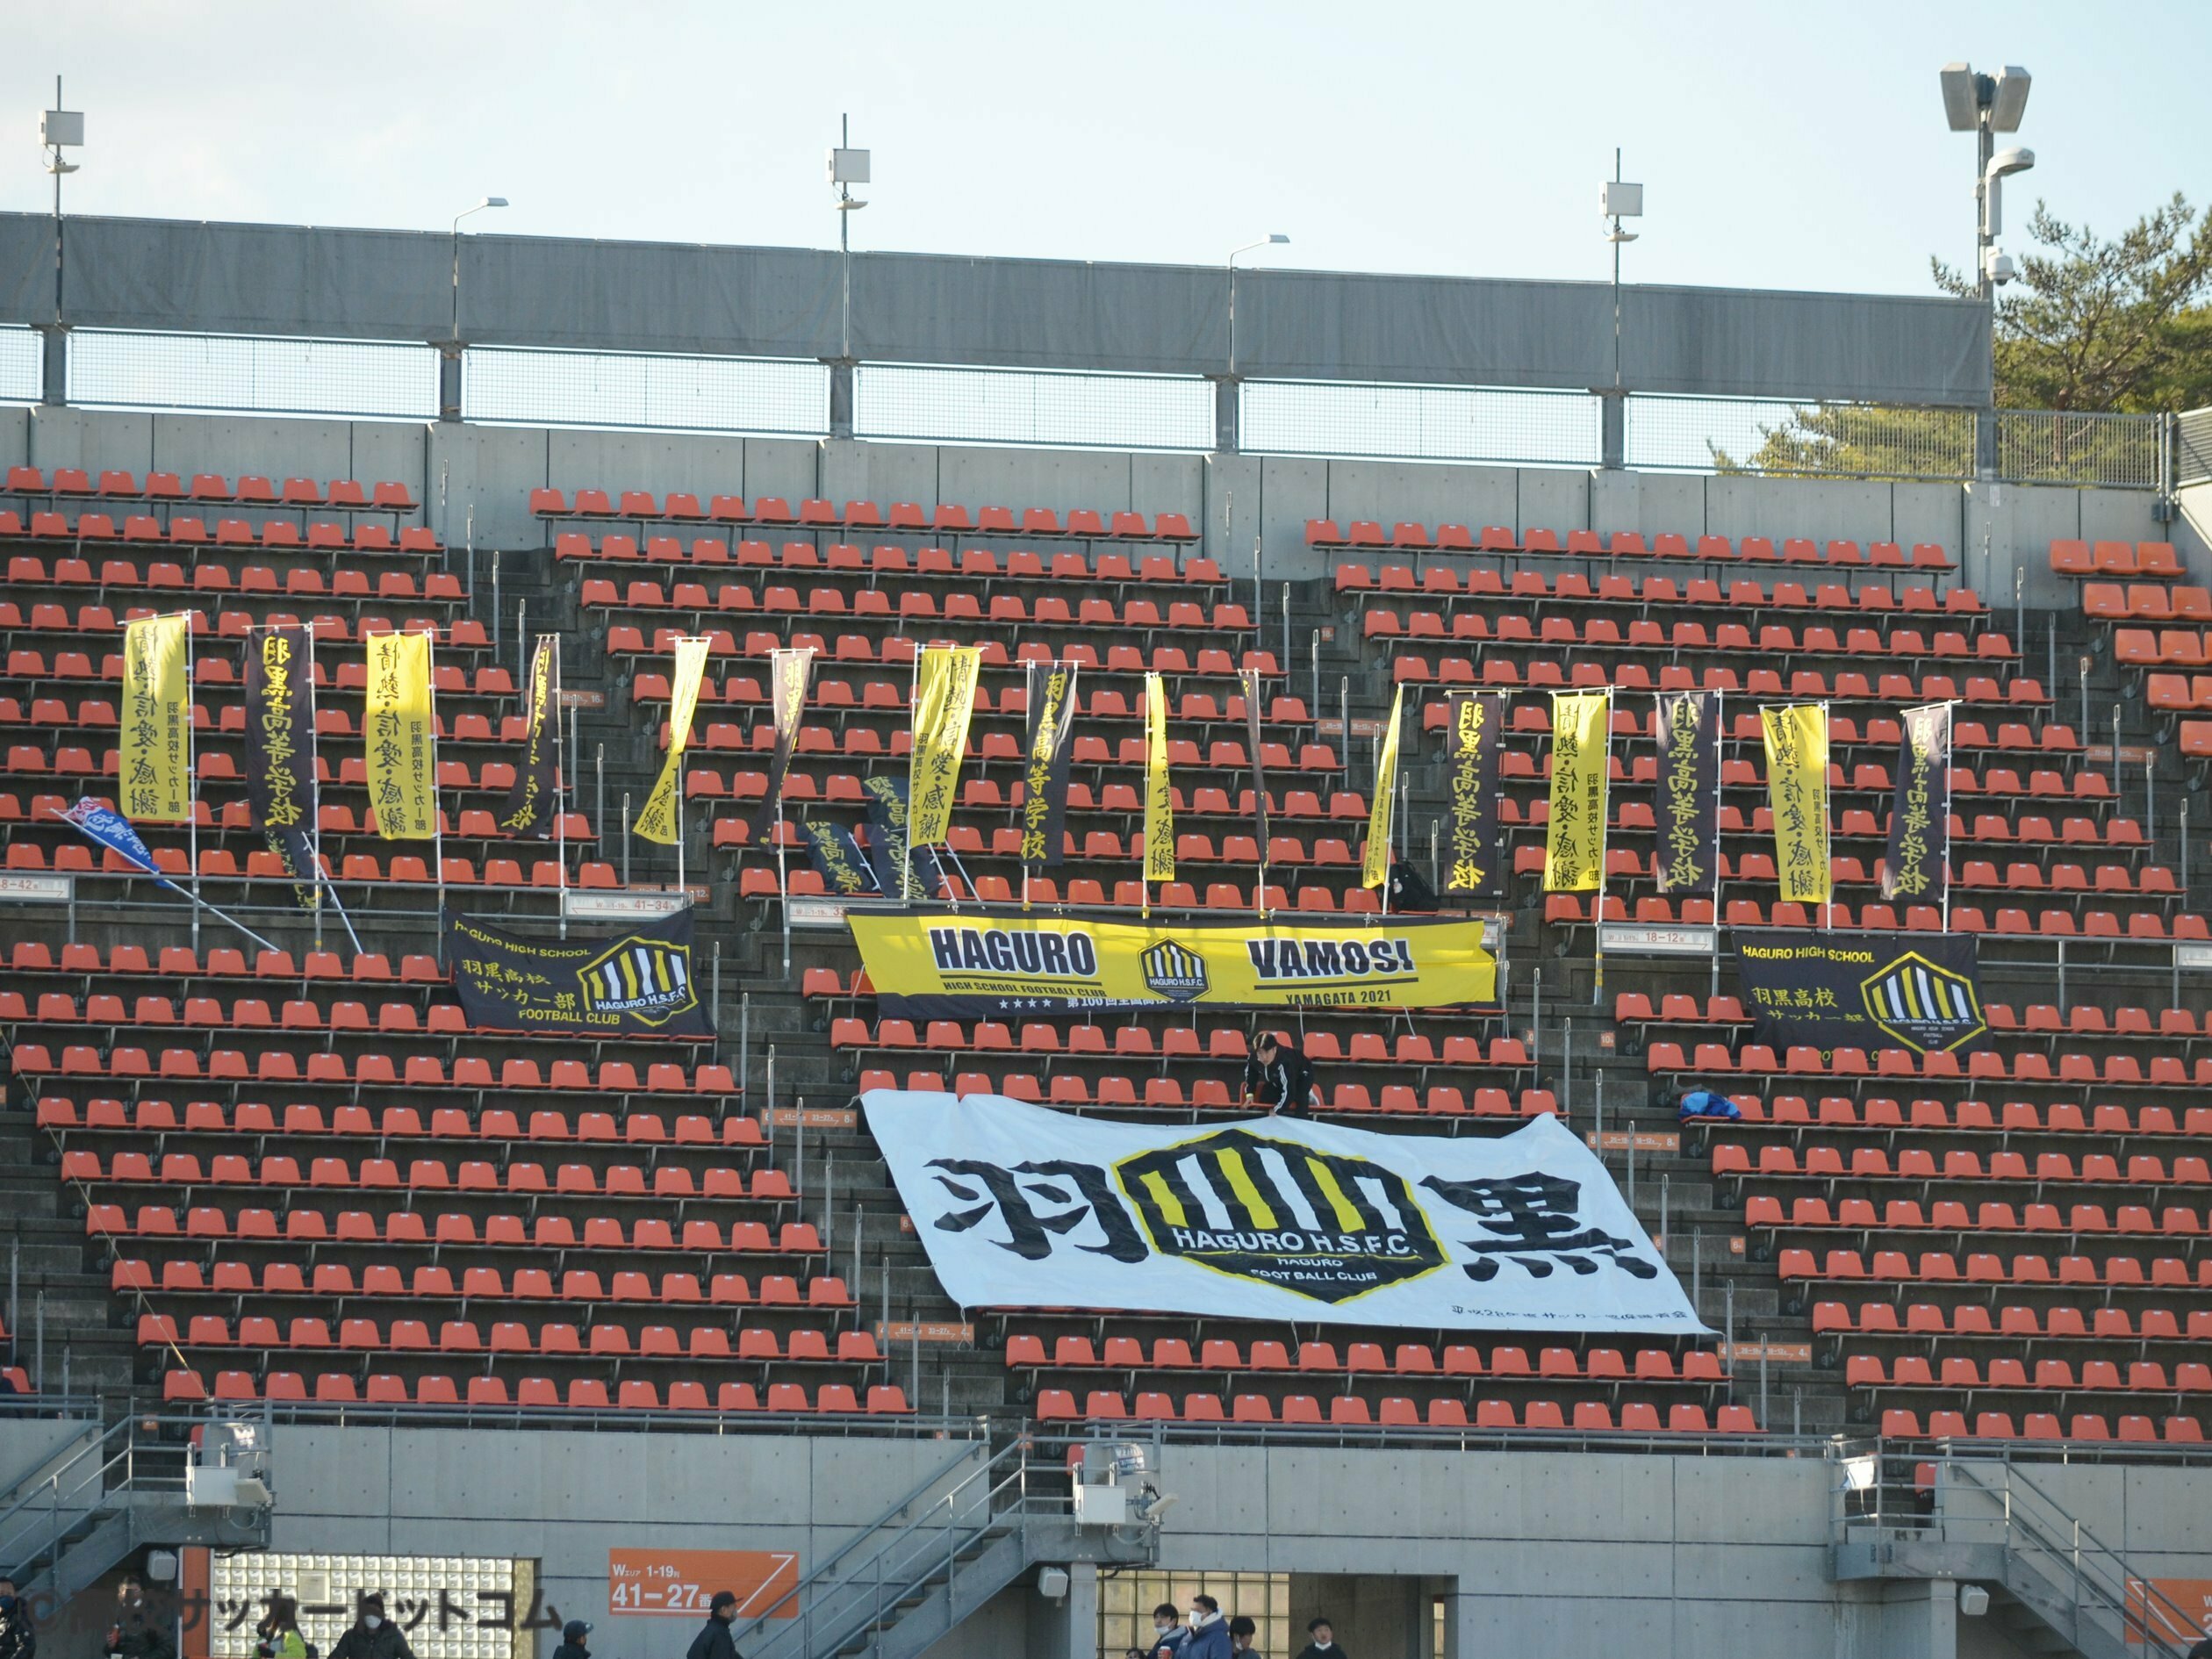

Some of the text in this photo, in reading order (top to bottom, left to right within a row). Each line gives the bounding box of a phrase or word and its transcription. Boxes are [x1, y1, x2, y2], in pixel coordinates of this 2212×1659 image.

[539, 948, 592, 959] SCHOOL
[929, 927, 1099, 978] HAGURO
[1742, 945, 1876, 963] HAGURO HIGH SCHOOL
[943, 980, 1108, 998] HIGH SCHOOL FOOTBALL CLUB
[1149, 977, 1180, 987] HAGURO
[594, 995, 648, 1012] HAGURO
[1285, 990, 1392, 1006] YAMAGATA 2021
[1751, 986, 1839, 1010] 羽黒高校
[519, 1008, 621, 1026] FOOTBALL CLUB
[923, 1158, 1659, 1283] 羽 黒
[1171, 1226, 1419, 1255] HAGURO H.S.F.C.
[1276, 1257, 1345, 1268] HAGURO
[1336, 1271, 1378, 1283] CLUB
